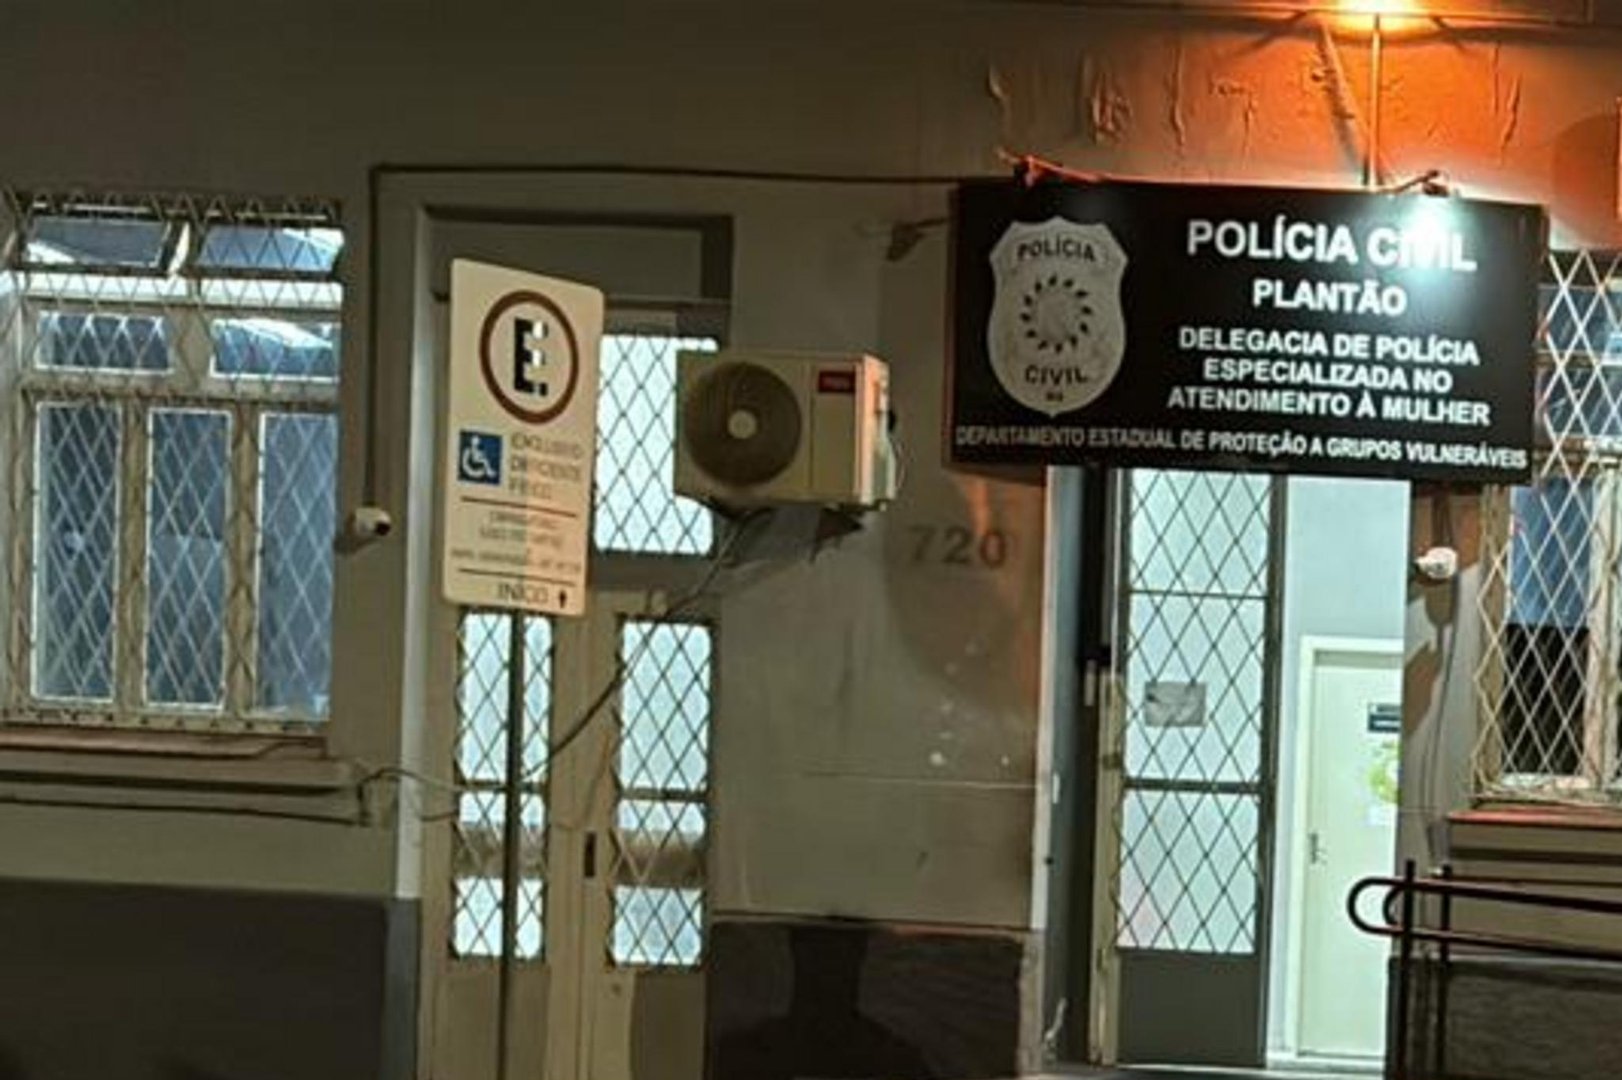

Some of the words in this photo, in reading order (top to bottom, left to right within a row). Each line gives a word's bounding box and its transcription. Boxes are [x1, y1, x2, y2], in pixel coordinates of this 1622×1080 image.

[1017, 236, 1095, 262] POLÍCIA
[1188, 214, 1358, 264] POLÍCIA
[1366, 228, 1477, 271] CIVIL
[1253, 278, 1408, 316] PLANTÃO
[1179, 326, 1328, 357] DELEGACIA
[1333, 334, 1368, 358] DE
[1376, 333, 1479, 365] POLÍCIA
[1025, 364, 1088, 385] CIVIL
[1203, 358, 1408, 390] ESPECIALIZADA
[1413, 368, 1453, 393] NO
[1167, 386, 1351, 417] ATENDIMENTO
[1382, 396, 1490, 425] MULHER
[956, 425, 1084, 447] DEPARTAMENTO
[1088, 427, 1175, 448] ESTADUAL
[1180, 429, 1204, 450] DE
[1208, 431, 1307, 457] PROTEÇÃO
[1309, 437, 1323, 455] A
[1326, 437, 1402, 461] GRUPOS
[1406, 440, 1528, 469] VULNERÁVEIS
[909, 525, 1006, 569] 720
